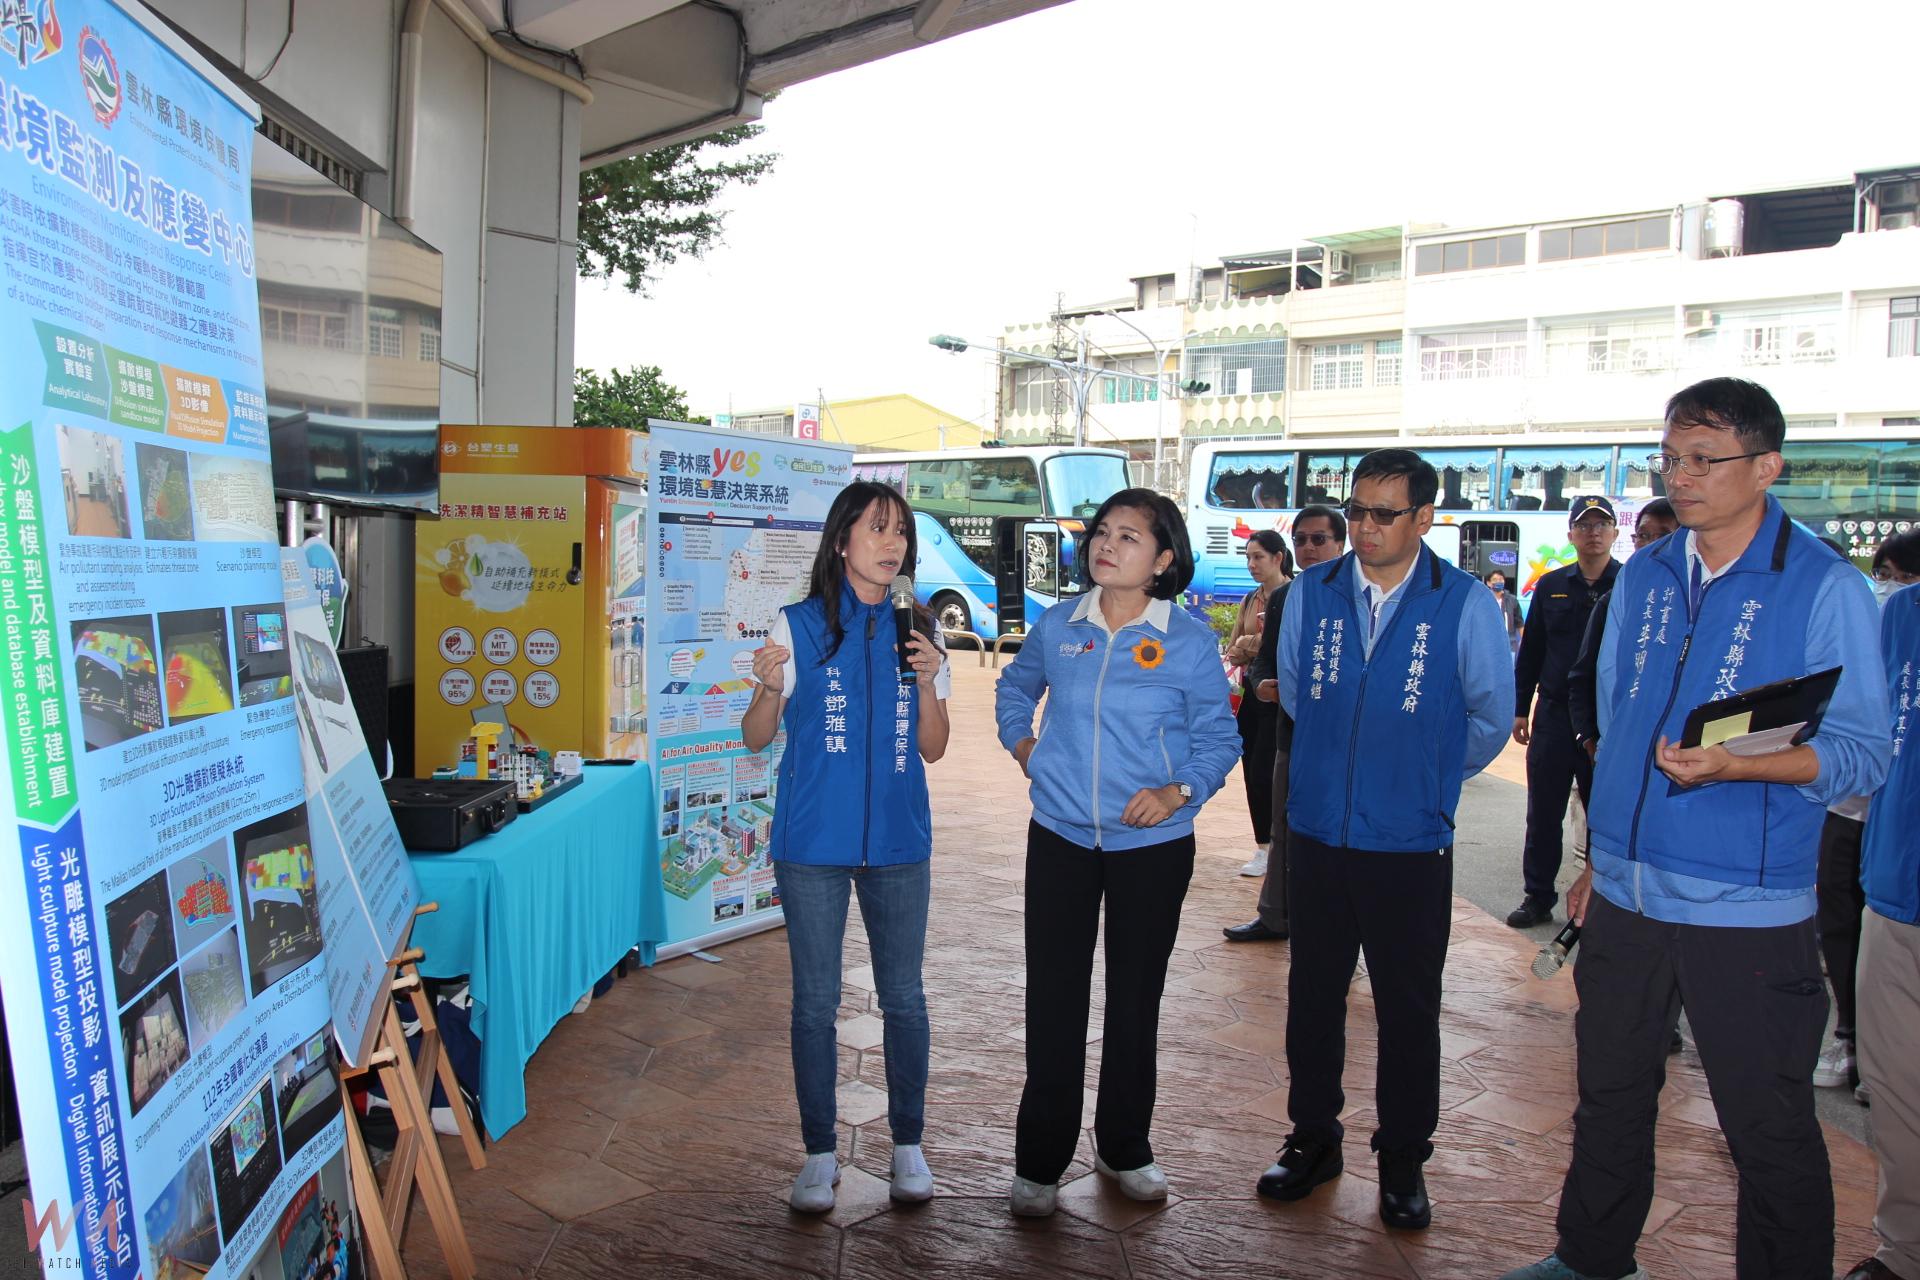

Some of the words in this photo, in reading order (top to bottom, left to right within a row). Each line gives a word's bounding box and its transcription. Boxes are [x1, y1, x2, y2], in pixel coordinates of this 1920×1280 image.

[165, 247, 206, 277] Response
[803, 424, 813, 438] G
[660, 450, 710, 475] 雲林縣
[712, 447, 762, 478] yes
[659, 475, 788, 505] 環境智慧決策系統
[730, 502, 751, 510] Decision
[752, 504, 771, 513] Support
[772, 505, 789, 513] System
[439, 503, 568, 521] 洗潔精智慧補充站
[2, 577, 21, 610] and
[10, 453, 70, 800] 沙盤模型及資料庫建置
[5, 612, 26, 691] database
[491, 641, 508, 650] MIT
[1328, 618, 1344, 684] 環境保護局
[1401, 623, 1431, 713] 雲林縣政府
[447, 690, 467, 699] 95%
[533, 692, 551, 701] 15%
[15, 693, 43, 808] establishment
[662, 749, 669, 758] AI
[670, 747, 681, 757] for
[682, 745, 694, 755] Air
[694, 742, 723, 754] Quality
[163, 755, 246, 804] 3D光雕擴散模擬系統
[243, 772, 265, 792] System
[31, 843, 54, 883] Light
[38, 885, 60, 953] sculpture
[49, 957, 71, 1003] model
[52, 1004, 79, 1080] projection
[67, 1093, 90, 1144] Digital
[77, 1144, 101, 1235] information
